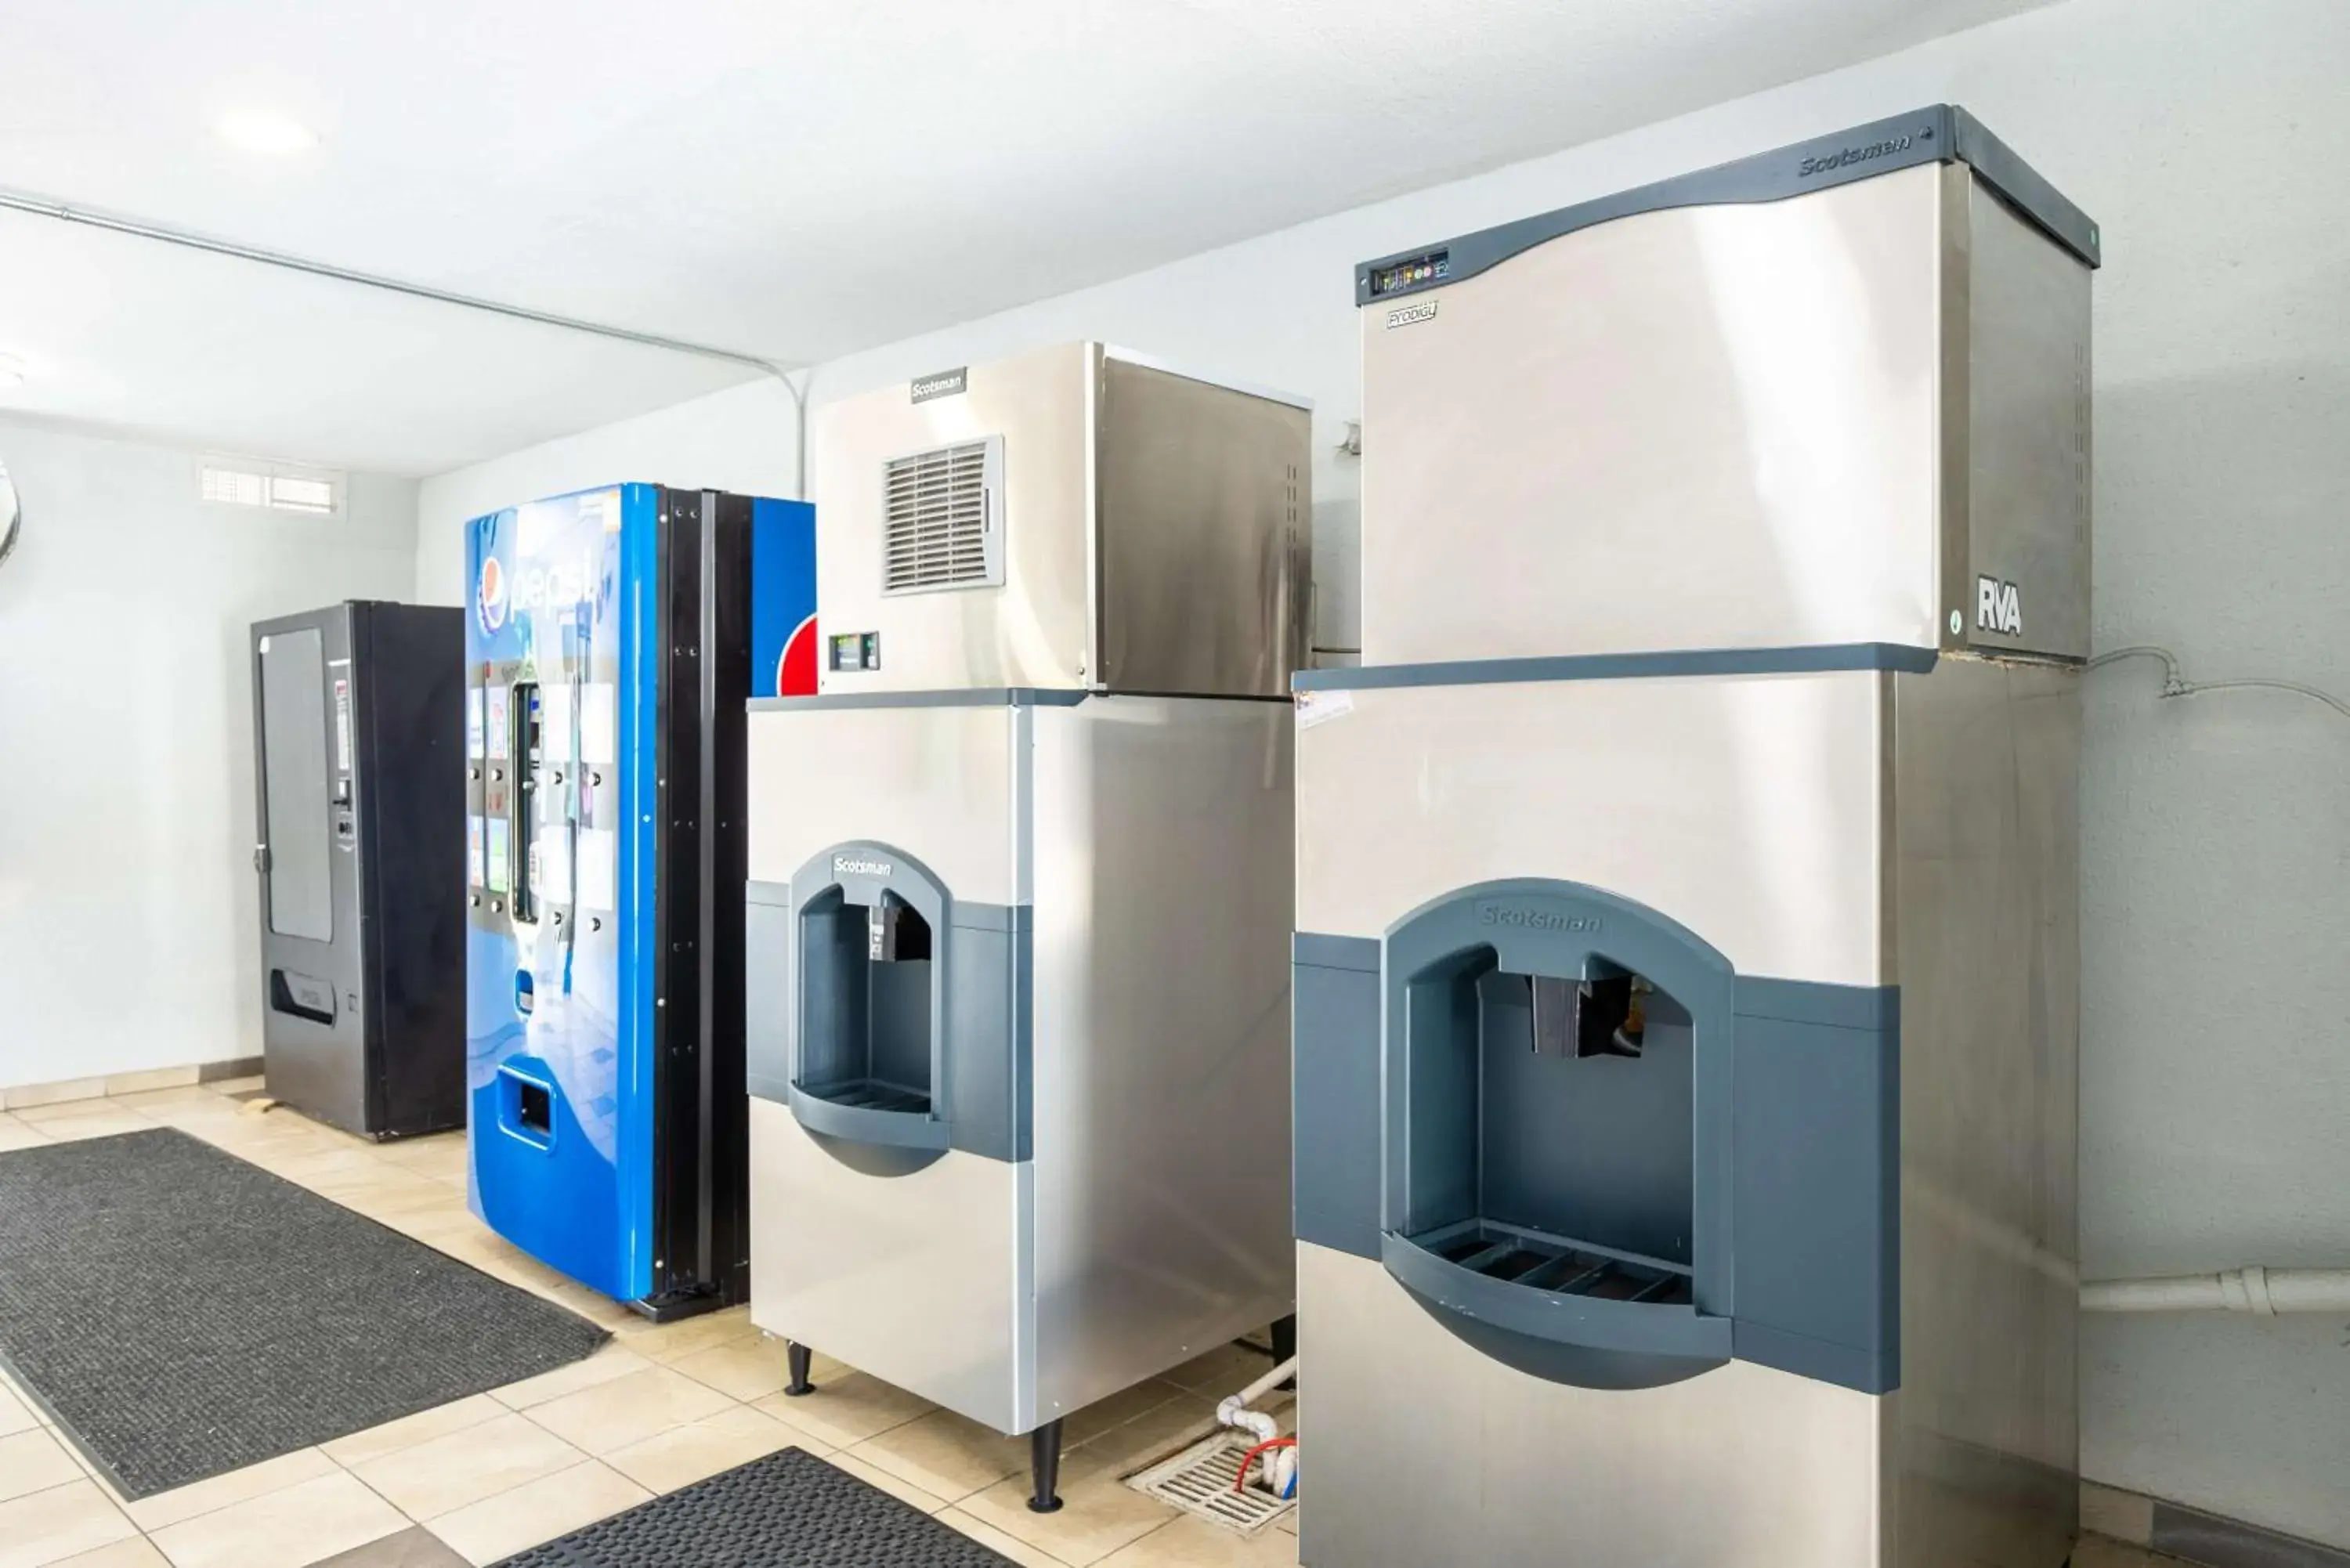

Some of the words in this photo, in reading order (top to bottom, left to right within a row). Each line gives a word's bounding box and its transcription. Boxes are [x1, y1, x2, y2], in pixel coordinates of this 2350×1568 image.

[1799, 135, 1912, 177] Scotsman
[913, 376, 961, 396] Scotsman
[1977, 574, 2022, 637] RVA
[833, 858, 891, 877] Scotsman
[1480, 904, 1603, 934] Scotsman
